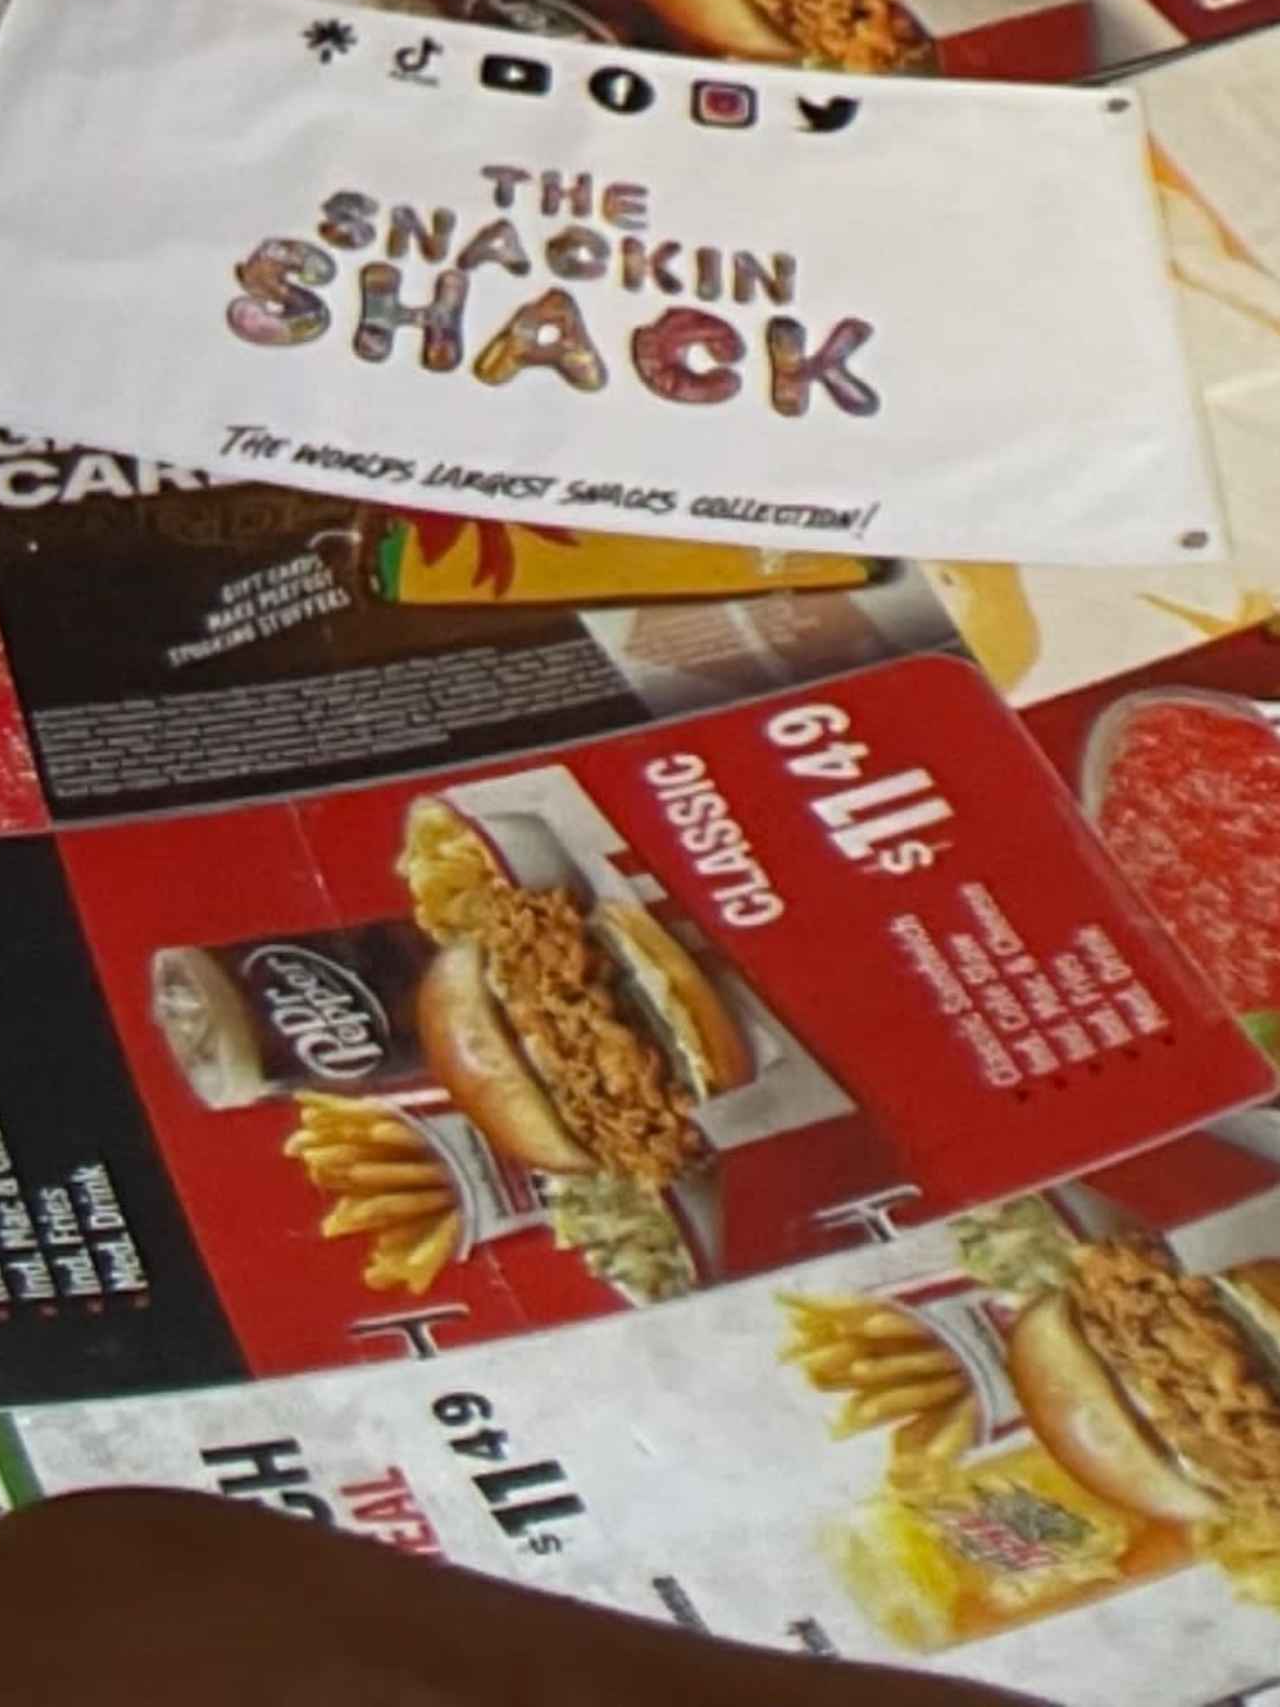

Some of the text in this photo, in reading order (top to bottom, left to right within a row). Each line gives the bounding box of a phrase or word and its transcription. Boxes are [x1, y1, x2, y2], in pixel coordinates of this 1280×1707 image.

[481, 164, 651, 232] THE
[318, 189, 798, 304] SNACKIN
[225, 236, 882, 420] SHACK
[219, 425, 286, 459] THE
[421, 460, 557, 503] LARGEST
[562, 477, 678, 514] SNACKS
[688, 500, 878, 540] COLLECTION!
[645, 753, 784, 928] CLASSIC
[0, 1201, 36, 1247] Mac
[40, 1188, 81, 1242] Fries
[72, 1164, 124, 1228] Drink
